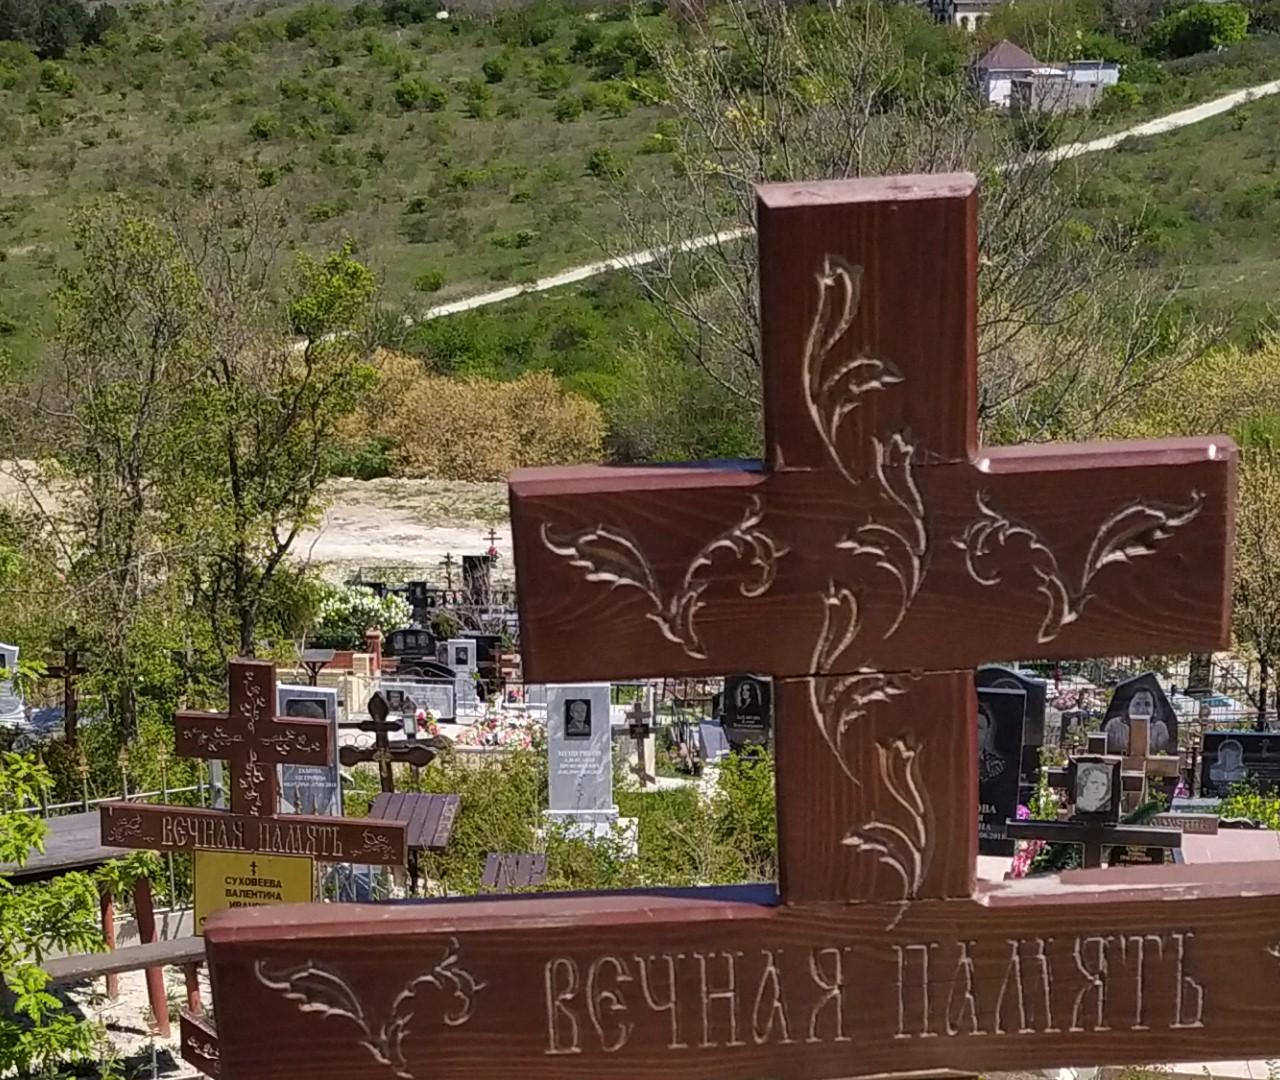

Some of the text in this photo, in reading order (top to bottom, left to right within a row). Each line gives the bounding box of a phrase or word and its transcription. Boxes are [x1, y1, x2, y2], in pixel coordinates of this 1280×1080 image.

[257, 822, 344, 857] ПАМЯТЬ
[224, 876, 283, 889] СУХОВЕЕВА
[225, 888, 283, 901] ВАЛЕНТИНА
[891, 932, 1206, 1040] ПАМЯТЬ
